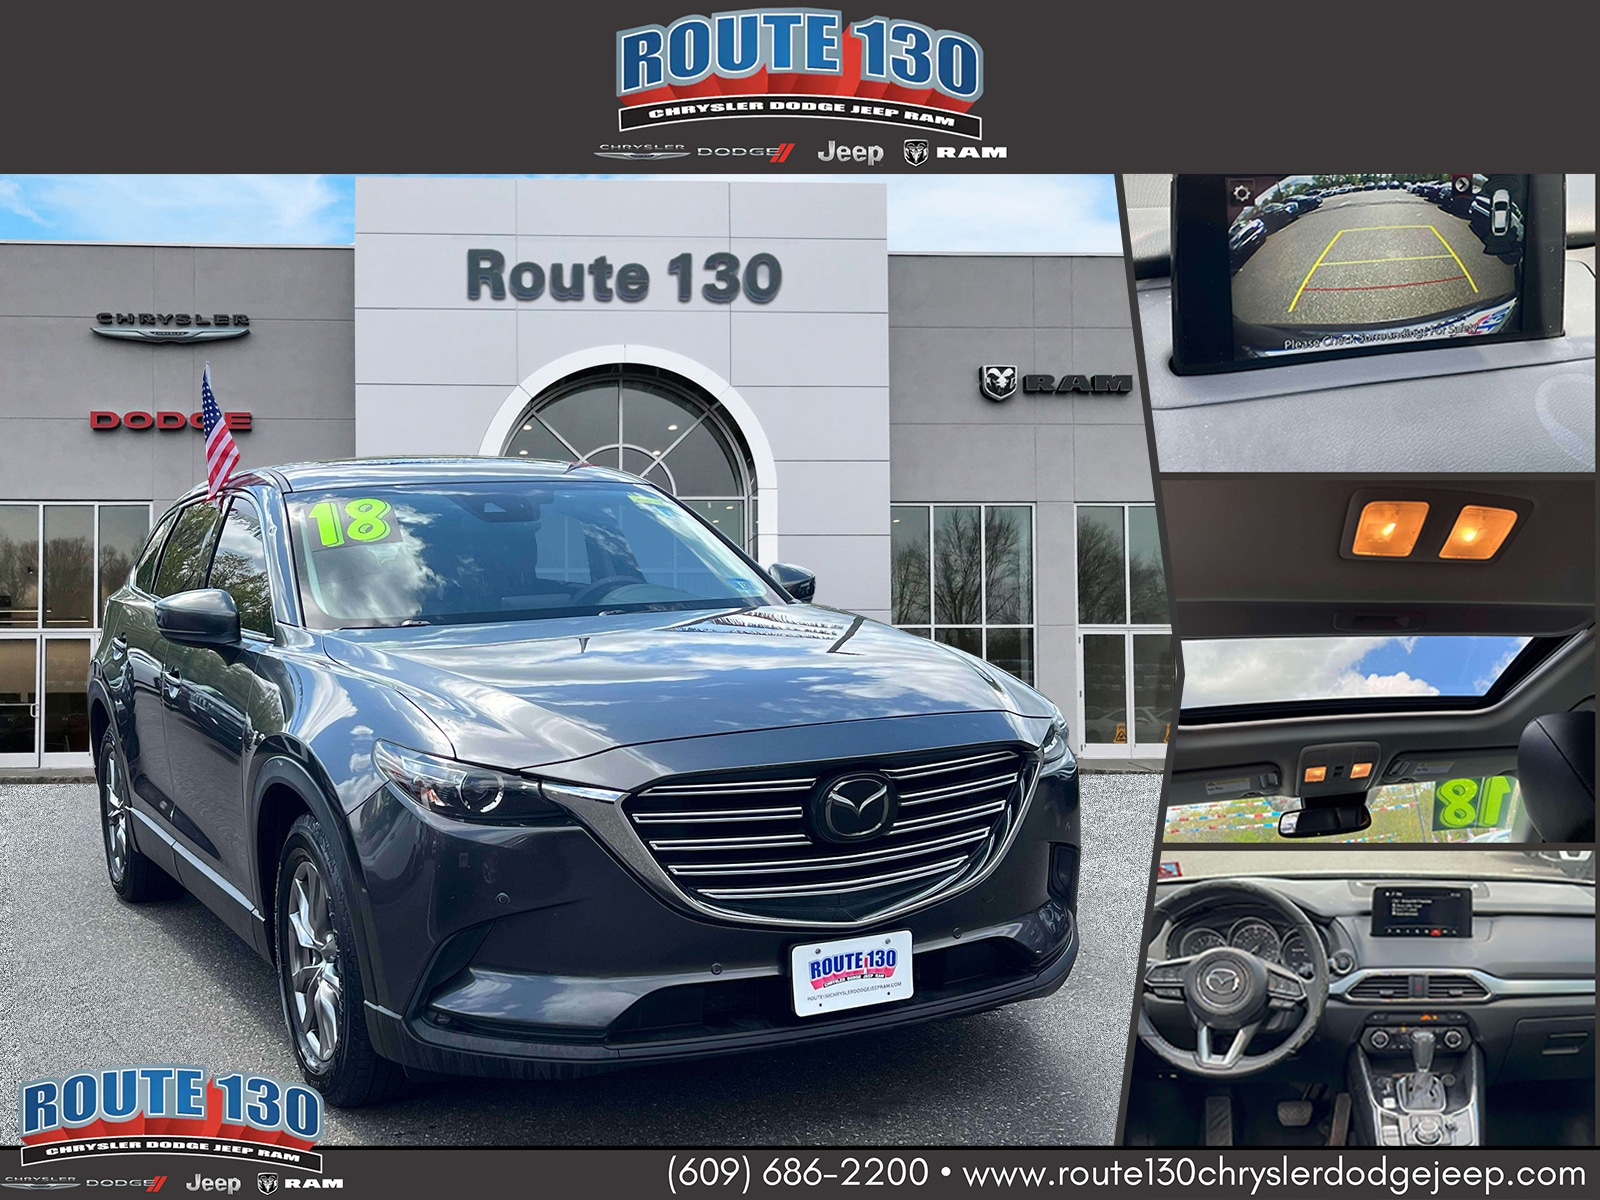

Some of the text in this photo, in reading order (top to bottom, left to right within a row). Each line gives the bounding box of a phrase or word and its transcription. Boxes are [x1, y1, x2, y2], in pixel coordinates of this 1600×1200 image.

[467, 248, 783, 305] Route 130
[96, 312, 250, 326] CHRYSLER
[1284, 338, 1321, 350] Please
[1322, 334, 1357, 347] Check
[1430, 323, 1447, 337] For
[1449, 322, 1480, 338] Safety
[1022, 374, 1133, 395] RAM
[308, 497, 392, 548] 18
[809, 949, 897, 979] ROUTE 130
